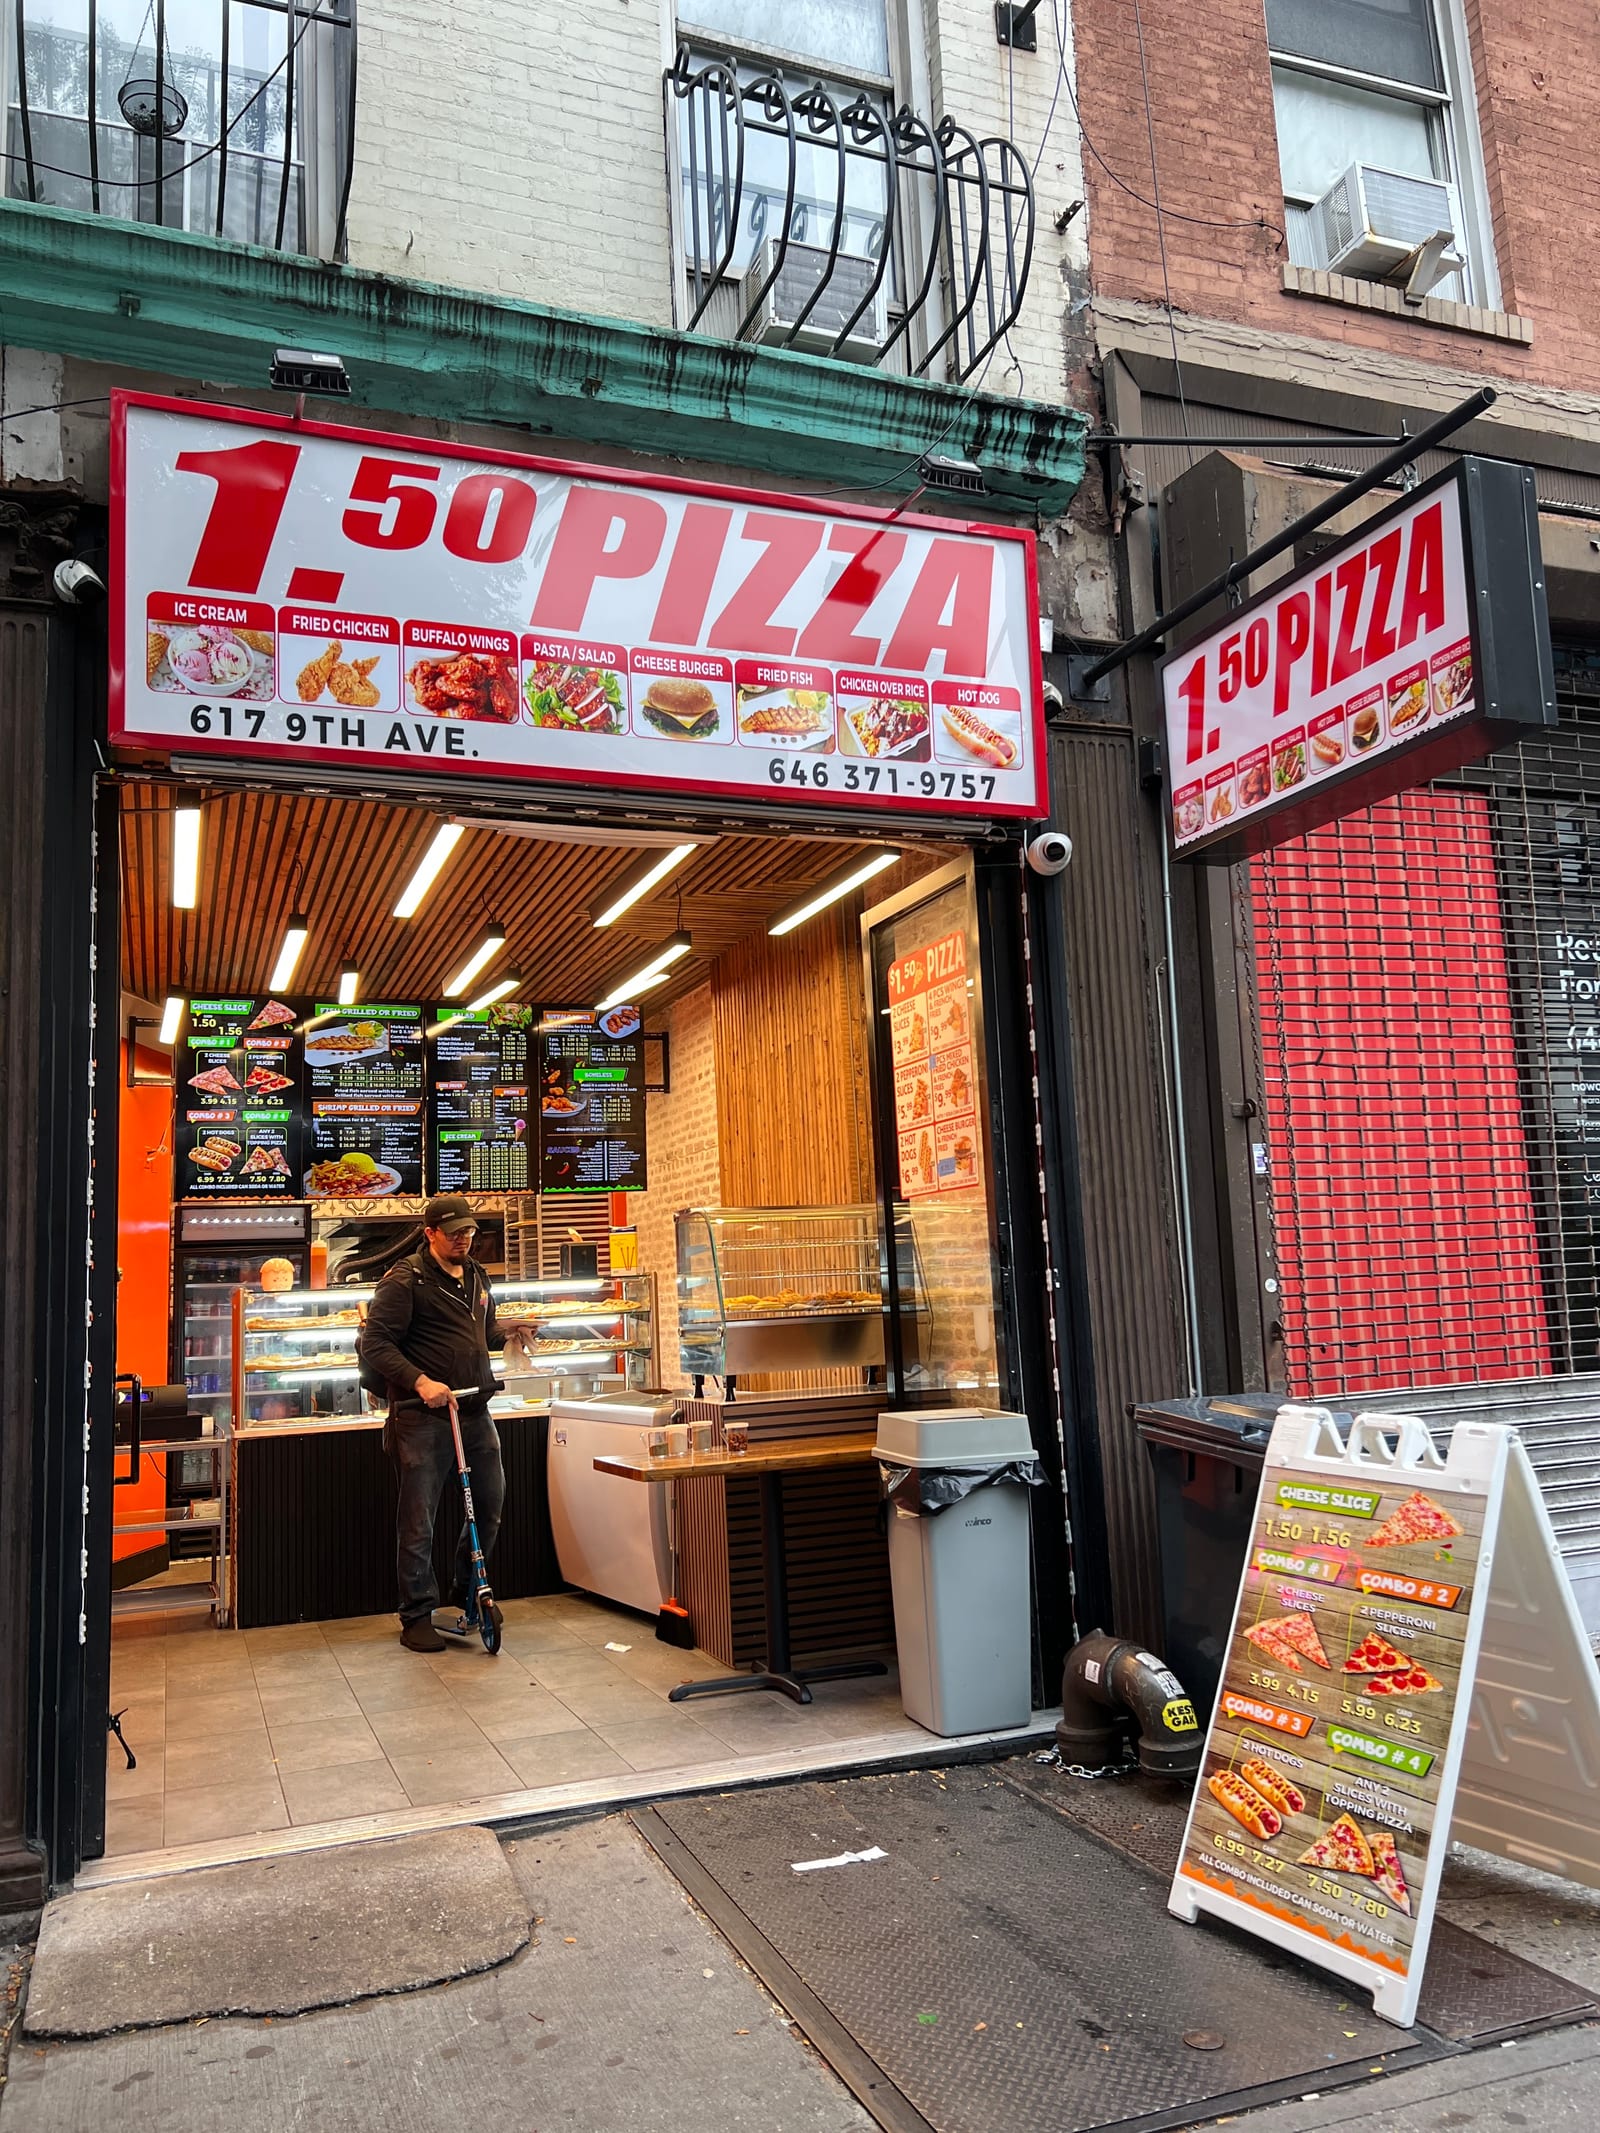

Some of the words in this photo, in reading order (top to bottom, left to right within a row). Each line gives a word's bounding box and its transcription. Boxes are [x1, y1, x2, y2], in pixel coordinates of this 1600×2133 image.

[175, 440, 537, 604] 1.50
[529, 484, 995, 679] PIZZA
[174, 602, 196, 619] ICE
[198, 605, 248, 624] CREAM
[292, 614, 331, 633] FRIED
[333, 619, 389, 639] CHICKEN
[1178, 617, 1269, 765] 1.50
[1273, 501, 1445, 717] PIZZA
[411, 627, 467, 648] BUFFALO
[469, 633, 510, 652] WINGS
[533, 642, 570, 659] PASTA
[578, 648, 616, 665] SALAD
[634, 655, 679, 672] CHEESE
[681, 659, 724, 677] BURGER
[757, 668, 788, 684] FRIED
[790, 670, 813, 686] FISH
[840, 676, 879, 693] CHICKEN
[880, 680, 903, 696] OVER
[904, 682, 925, 698] RICE
[957, 688, 975, 702] HOT
[976, 690, 1001, 704] DOG
[189, 704, 266, 738] 617
[286, 712, 366, 747] 9TH
[384, 721, 480, 758] AVE.
[768, 758, 829, 787] 646
[843, 764, 997, 801] 371-9757
[889, 960, 916, 995] $1.50
[926, 935, 965, 983] PIZZA
[933, 986, 944, 998] PCS
[944, 979, 966, 995] WINGS
[893, 1007, 897, 1018] 2
[896, 999, 916, 1017] CHEESE
[192, 1018, 217, 1028] 1.50
[218, 1026, 243, 1036] 1.56
[894, 1017, 910, 1033] SLICES
[190, 1037, 217, 1046] COMBO
[246, 1038, 272, 1047] COMBO
[896, 1072, 900, 1083] 2
[900, 1063, 929, 1081] PEPPERONI
[946, 1056, 969, 1070] CHICKEN
[897, 1082, 914, 1097] SLICES
[937, 1122, 955, 1135] CHEESE
[955, 1117, 976, 1130] BURGER
[900, 1136, 905, 1148] 2
[905, 1133, 916, 1146] HOT
[901, 1148, 917, 1162] DOGS
[464, 1487, 475, 1522] Razor
[1279, 1485, 1329, 1505] CHEESE
[1331, 1493, 1372, 1511] SLICE
[1265, 1519, 1302, 1540] 1.50
[1311, 1525, 1352, 1548] 1.56
[1257, 1552, 1305, 1572] COMBO
[1308, 1562, 1319, 1575] #
[1322, 1564, 1330, 1577] 1
[1276, 1585, 1284, 1593] 2
[1283, 1587, 1326, 1603] CHEESE
[1360, 1573, 1416, 1595] COMBO
[1419, 1585, 1433, 1599] #
[1437, 1589, 1449, 1602] 2
[1281, 1598, 1317, 1613] SLICES
[1360, 1606, 1368, 1616] 2
[1369, 1608, 1437, 1631] PEPPERONI
[1375, 1622, 1416, 1639] SLICES
[1249, 1672, 1280, 1691] 3.99
[1286, 1684, 1320, 1703] 4.15
[1225, 1696, 1274, 1722] COMBO
[1276, 1713, 1289, 1727] #
[1291, 1717, 1303, 1731] 3
[1340, 1699, 1377, 1721] 5.99
[1384, 1712, 1422, 1734] 6.23
[1242, 1739, 1250, 1749] 2
[1251, 1742, 1273, 1758] HOT
[1273, 1748, 1304, 1768] DOGS
[1331, 1730, 1388, 1759] COMBO
[1391, 1749, 1406, 1765] #
[1409, 1756, 1421, 1770] 4
[1355, 1777, 1381, 1792] ANY
[1381, 1786, 1391, 1797] 2
[1333, 1782, 1374, 1805] SLICES
[1373, 1797, 1408, 1817] WITH
[1325, 1793, 1377, 1820] TOPPING
[1376, 1811, 1413, 1834] PIZZA
[1213, 1834, 1246, 1858] 6.99
[1252, 1850, 1286, 1874] 7.27
[1199, 1852, 1215, 1867] ALL
[1214, 1859, 1247, 1880] COMBO
[1246, 1873, 1292, 1901] INCLUDED
[1291, 1893, 1312, 1912] CAN
[1312, 1900, 1342, 1923] SODA
[1342, 1914, 1358, 1928] OR
[1357, 1922, 1395, 1947] WATER
[1307, 1873, 1343, 1900] 7.50
[1350, 1892, 1388, 1920] 7.80
